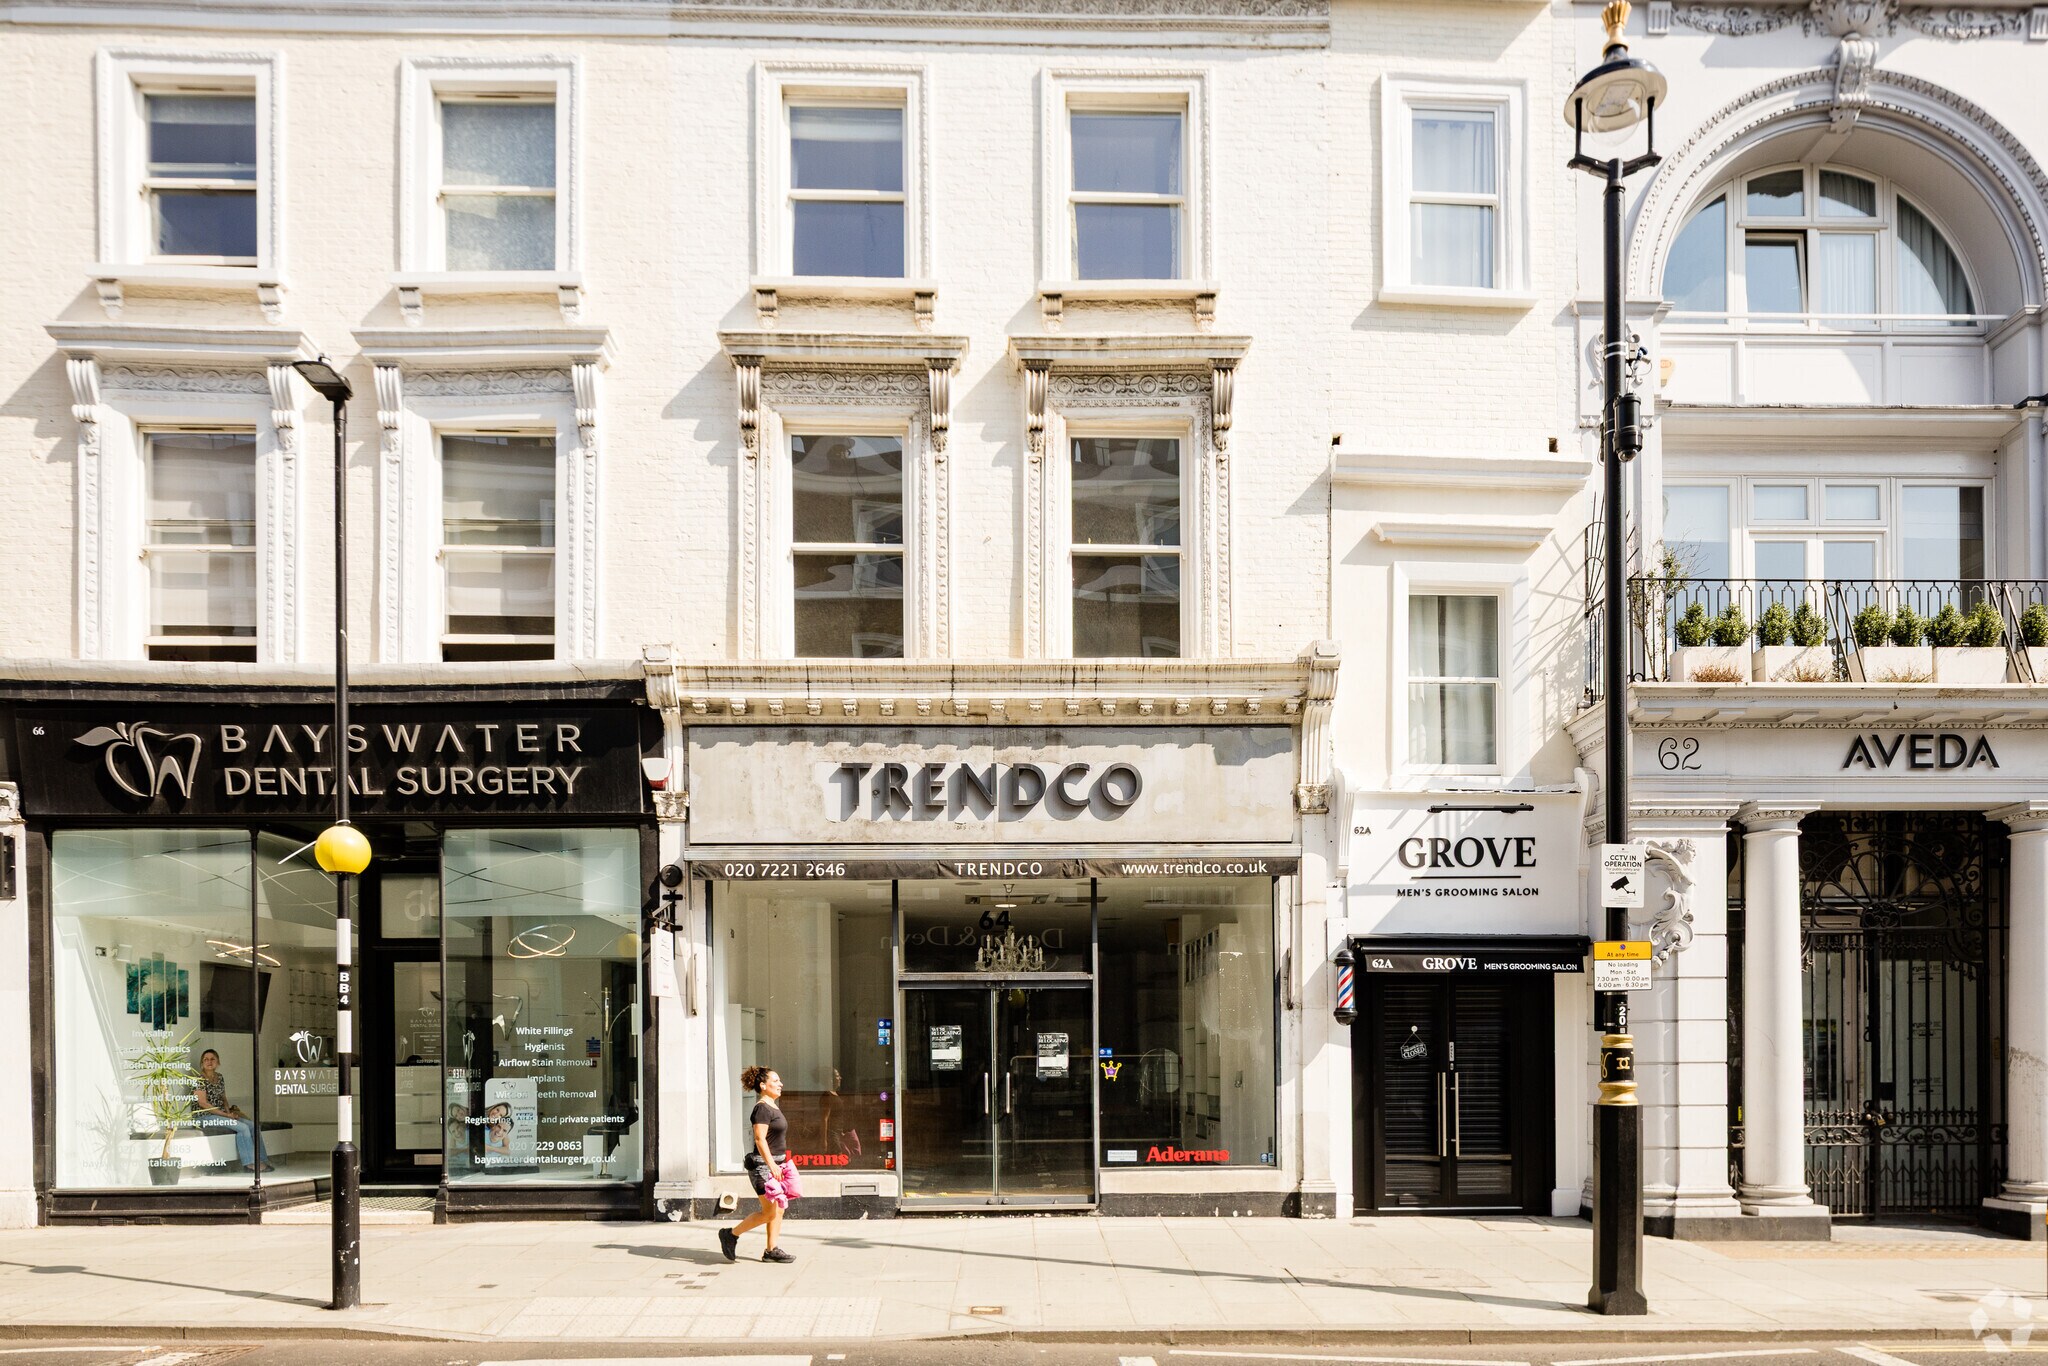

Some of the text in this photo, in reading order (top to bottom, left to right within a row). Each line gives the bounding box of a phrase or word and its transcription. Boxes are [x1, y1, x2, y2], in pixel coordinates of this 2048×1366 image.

[32, 726, 45, 736] 66
[219, 724, 582, 752] BAYSWATER
[1658, 737, 1702, 770] 62
[1843, 734, 2000, 768] AVEDA
[224, 766, 582, 795] DENTAL SURGERY
[841, 762, 1143, 808] TRENDCO
[1354, 826, 1371, 835] 62A
[1398, 837, 1537, 868] GROVE
[725, 863, 845, 877] 020 7221 2646
[954, 862, 1043, 876] TRENDCO
[1122, 860, 1267, 874] www.trendco.co.uk
[1397, 887, 1539, 897] MEN'S GROOMING SALON
[978, 910, 1011, 930] 64
[1372, 958, 1393, 969] 62A
[1422, 957, 1477, 970] GROVE
[1552, 963, 1578, 971] SALON
[339, 972, 350, 1004] BB4
[132, 1029, 174, 1039] Invisalign
[516, 1027, 573, 1036] White Fillings
[146, 1045, 191, 1053] Aesthetics
[525, 1043, 565, 1052] Hygienist
[1403, 1047, 1425, 1058] CLOSED
[147, 1061, 191, 1071] Whitening
[275, 1070, 339, 1080] BAYSWATE
[528, 1075, 565, 1084] Implants
[161, 1077, 198, 1087] Bonding
[275, 1083, 339, 1095] DENTAL SURGE
[560, 1090, 597, 1098] Removal
[171, 1119, 201, 1128] private
[203, 1119, 237, 1128] patients
[465, 1115, 511, 1125] Registering
[541, 1115, 557, 1123] and
[560, 1115, 588, 1125] private
[591, 1115, 624, 1125] patients
[511, 1141, 582, 1150] 020 7229 0863
[1146, 1146, 1230, 1162] Aderans
[474, 1155, 616, 1165] bayswaterdentalsurgery.co.uk
